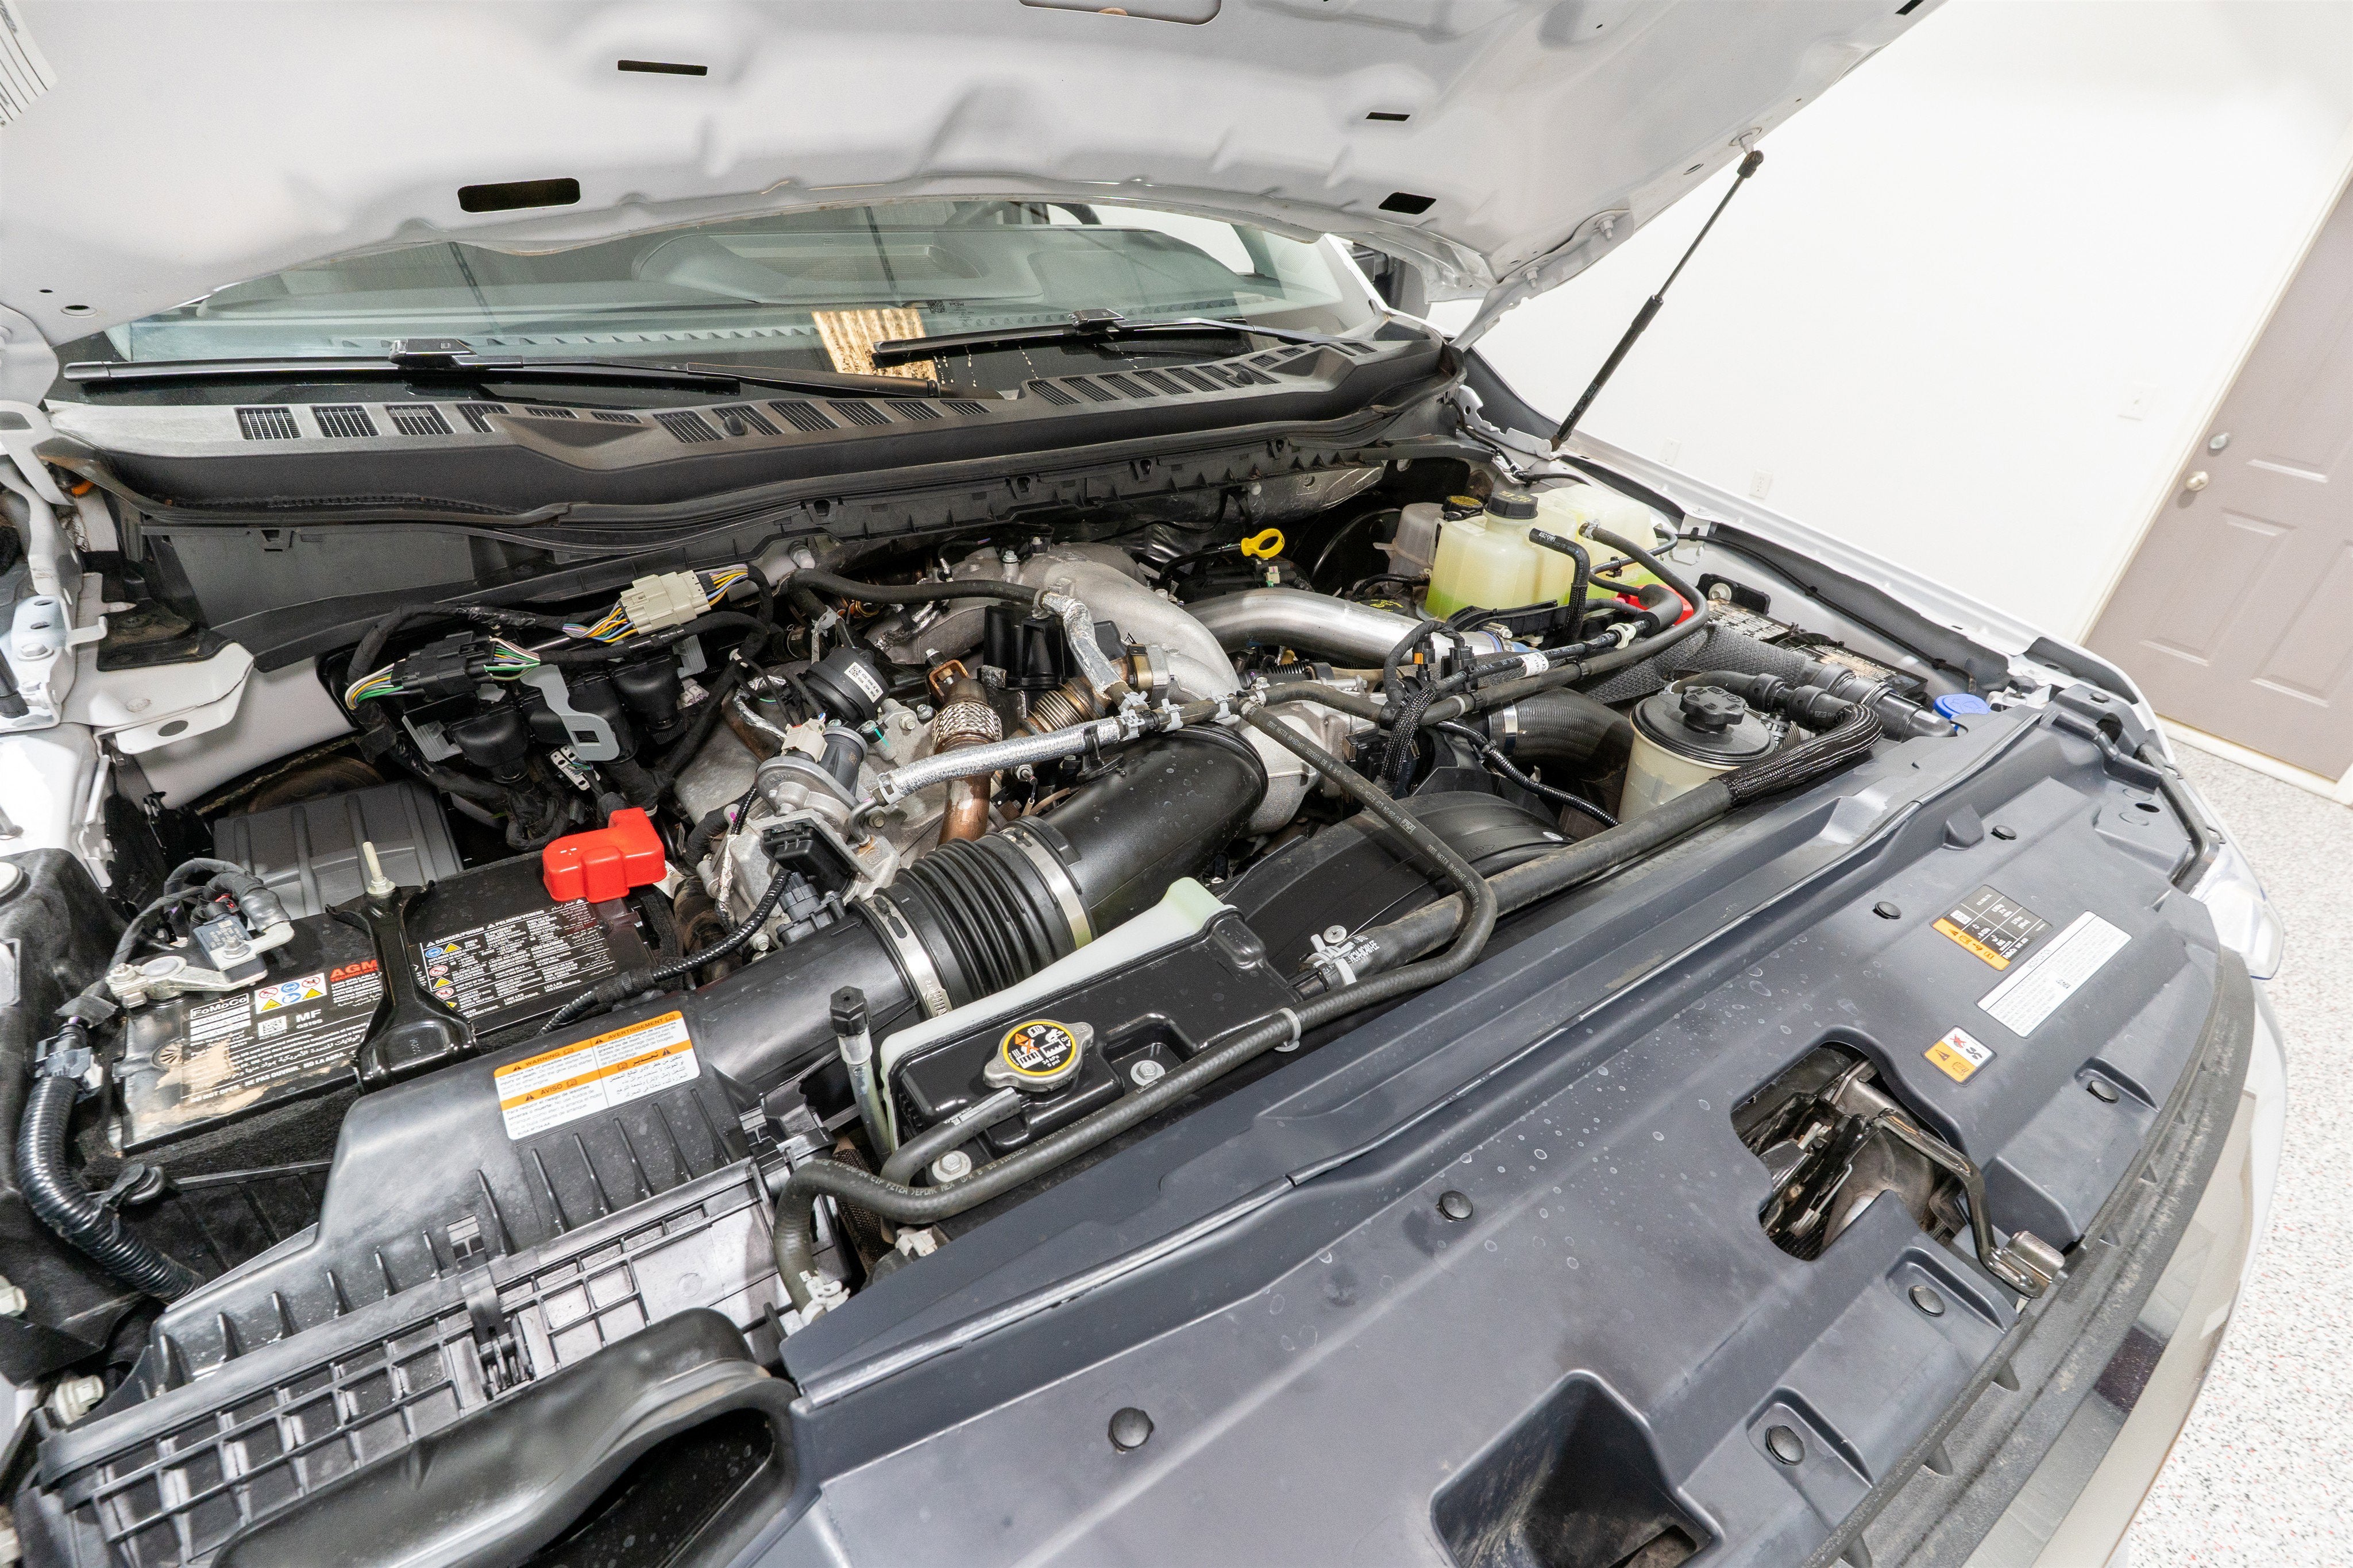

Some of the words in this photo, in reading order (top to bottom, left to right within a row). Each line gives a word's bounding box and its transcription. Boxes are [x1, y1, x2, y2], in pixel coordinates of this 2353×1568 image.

[495, 909, 545, 927] PELIGRO/VENENO
[435, 926, 484, 945] DANGER/POISON
[330, 959, 378, 979] AGM
[545, 978, 583, 992] INSTRUCCIONES.
[193, 997, 247, 1016] FoMoCo
[465, 1003, 501, 1018] NSTRUCTIONS.
[296, 1009, 321, 1022] MF
[608, 1018, 664, 1039] AVERTISSEMENT
[1060, 1034, 1070, 1043] OK
[526, 1052, 560, 1066] WARNING
[1048, 1053, 1060, 1063] kPa
[244, 1079, 254, 1087] NE
[256, 1073, 270, 1083] PAS
[271, 1064, 300, 1078] OUVRIR.
[303, 1060, 314, 1068] NO
[325, 1051, 346, 1062] ABRA.
[541, 1084, 563, 1096] AVISO
